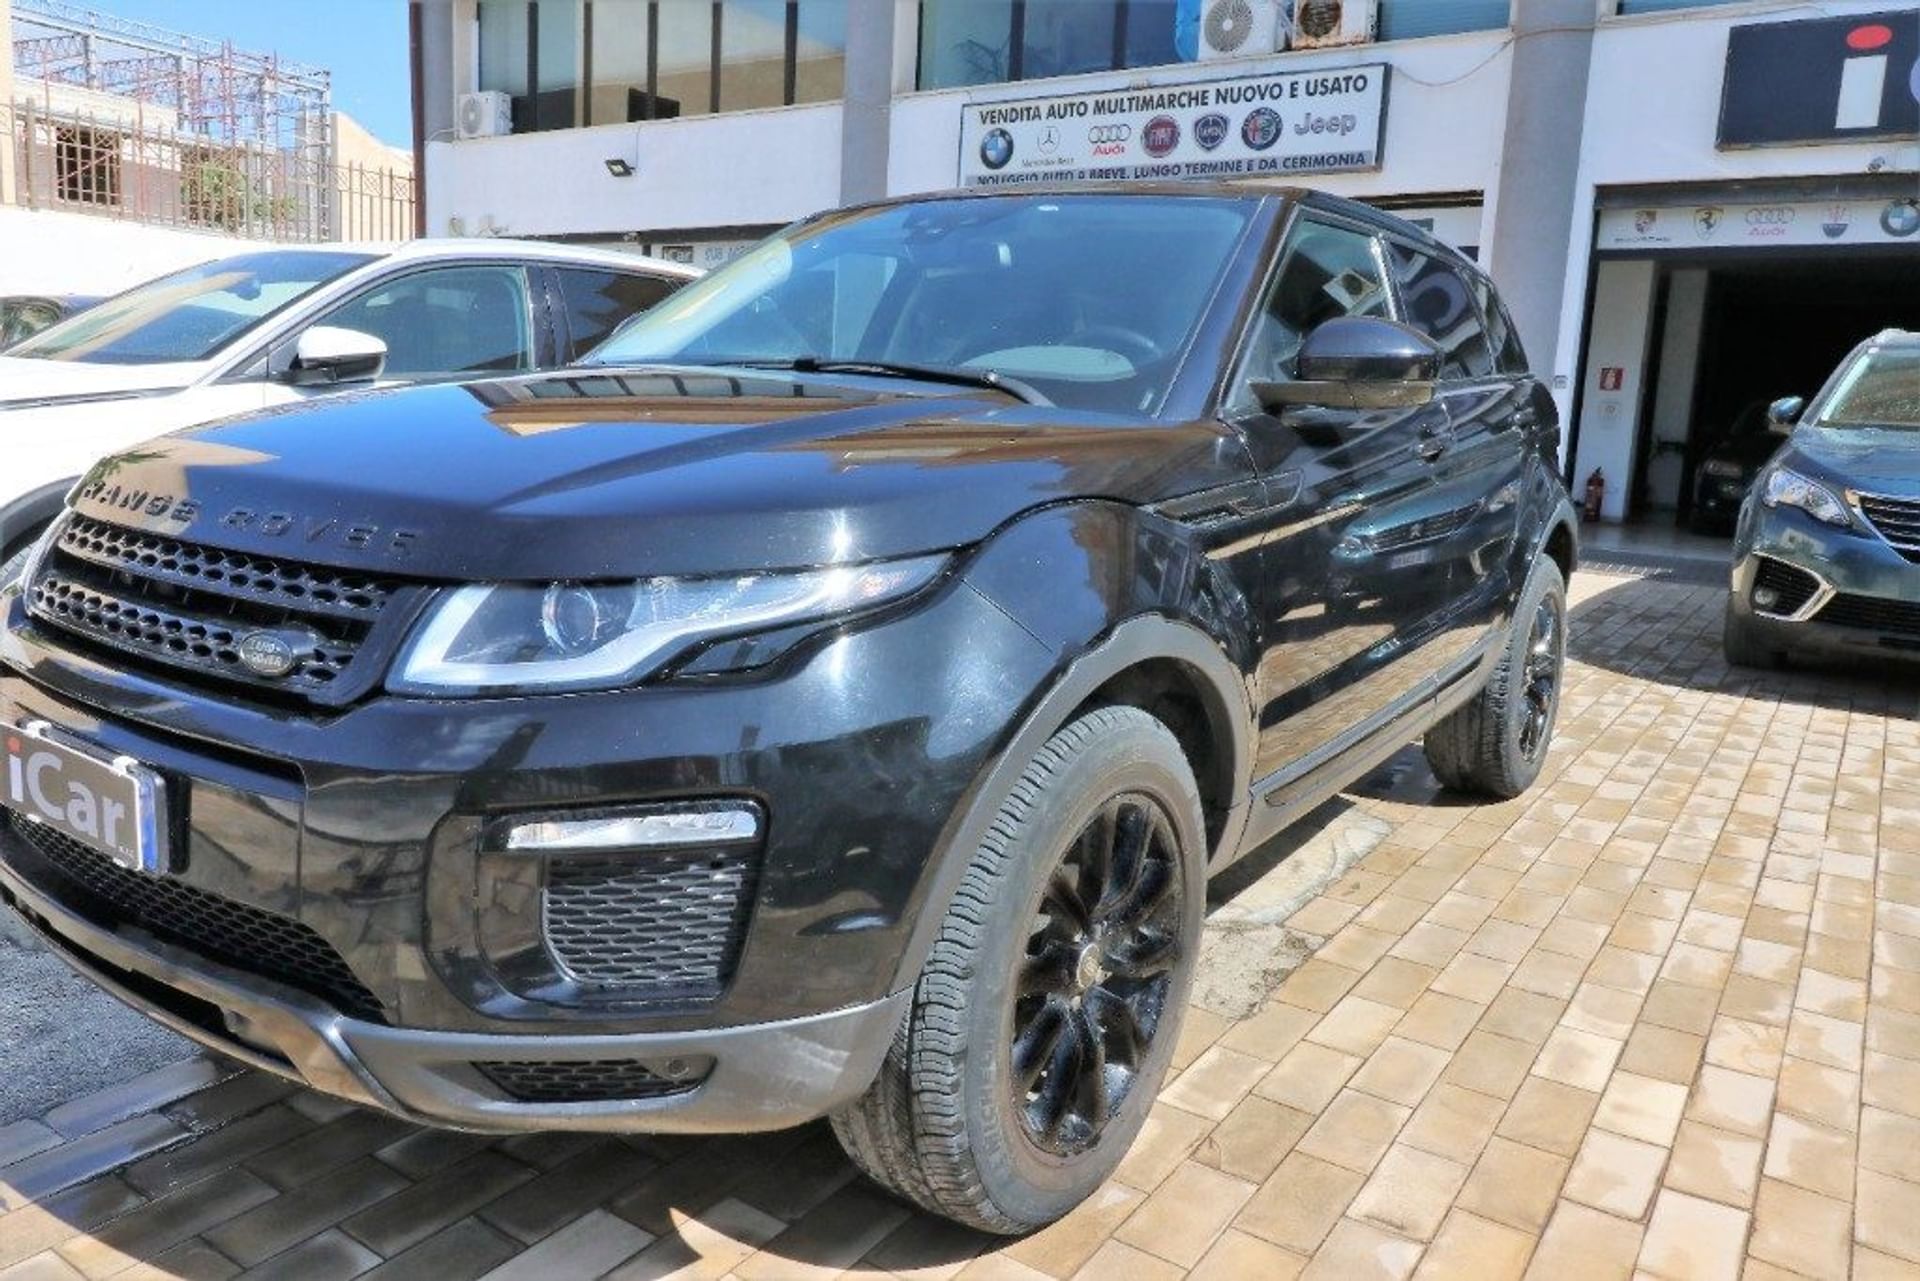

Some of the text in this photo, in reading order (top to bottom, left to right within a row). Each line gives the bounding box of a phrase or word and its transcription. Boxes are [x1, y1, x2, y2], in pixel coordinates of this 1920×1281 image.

[979, 74, 1368, 125] VENDITA AUTO MULTIMARCHE NUOVO E USATO
[1294, 112, 1356, 136] Jeep
[1093, 144, 1126, 156] Audi
[1134, 163, 1181, 179] LUNGO
[1185, 160, 1243, 176] TERMINE
[1247, 160, 1254, 171] E
[1258, 158, 1279, 171] DA
[1282, 152, 1366, 170] CERIMONIA
[83, 480, 200, 523] RANGE
[7, 736, 125, 848] iCar
